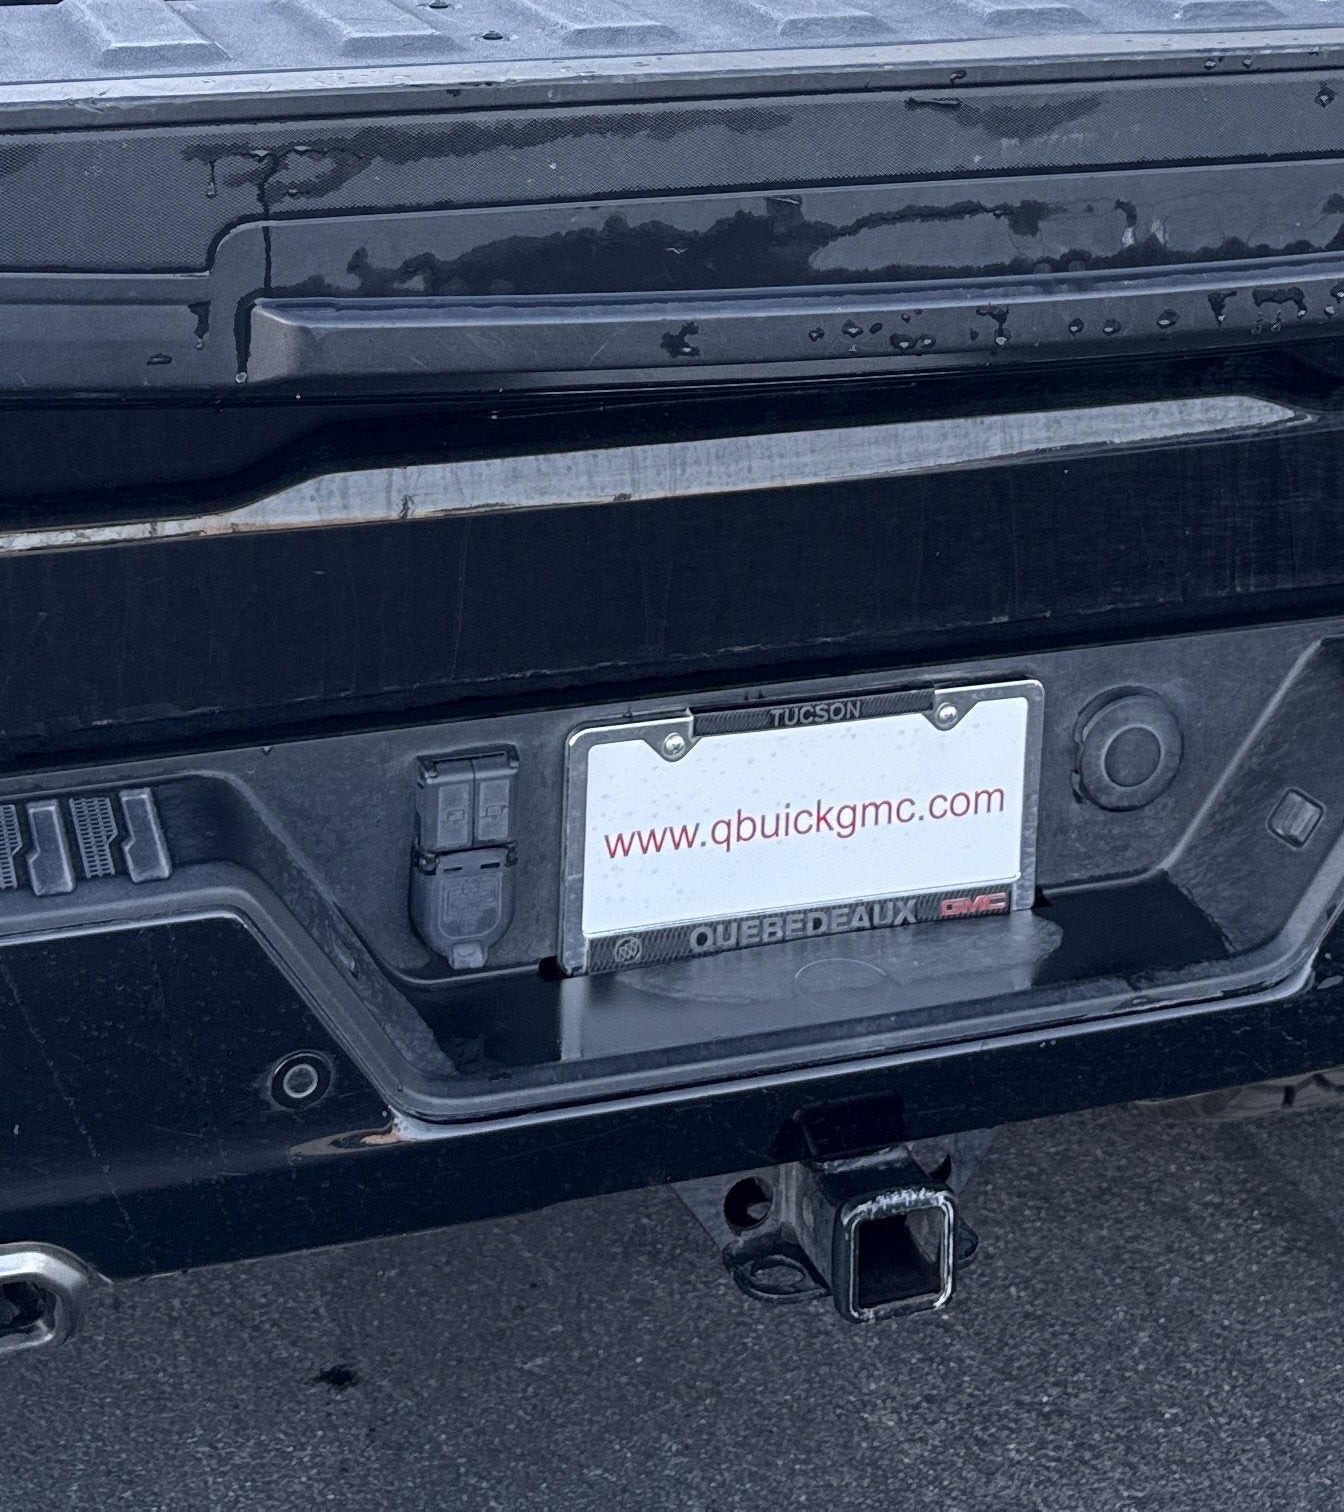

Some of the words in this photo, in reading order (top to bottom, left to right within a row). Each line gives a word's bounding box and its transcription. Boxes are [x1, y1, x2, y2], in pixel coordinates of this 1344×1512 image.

[770, 700, 862, 728] TUCSON
[603, 787, 1005, 859] www.qbuickgmc.com
[689, 898, 919, 954] QUEBEDEAUX
[940, 891, 1007, 918] GMC
